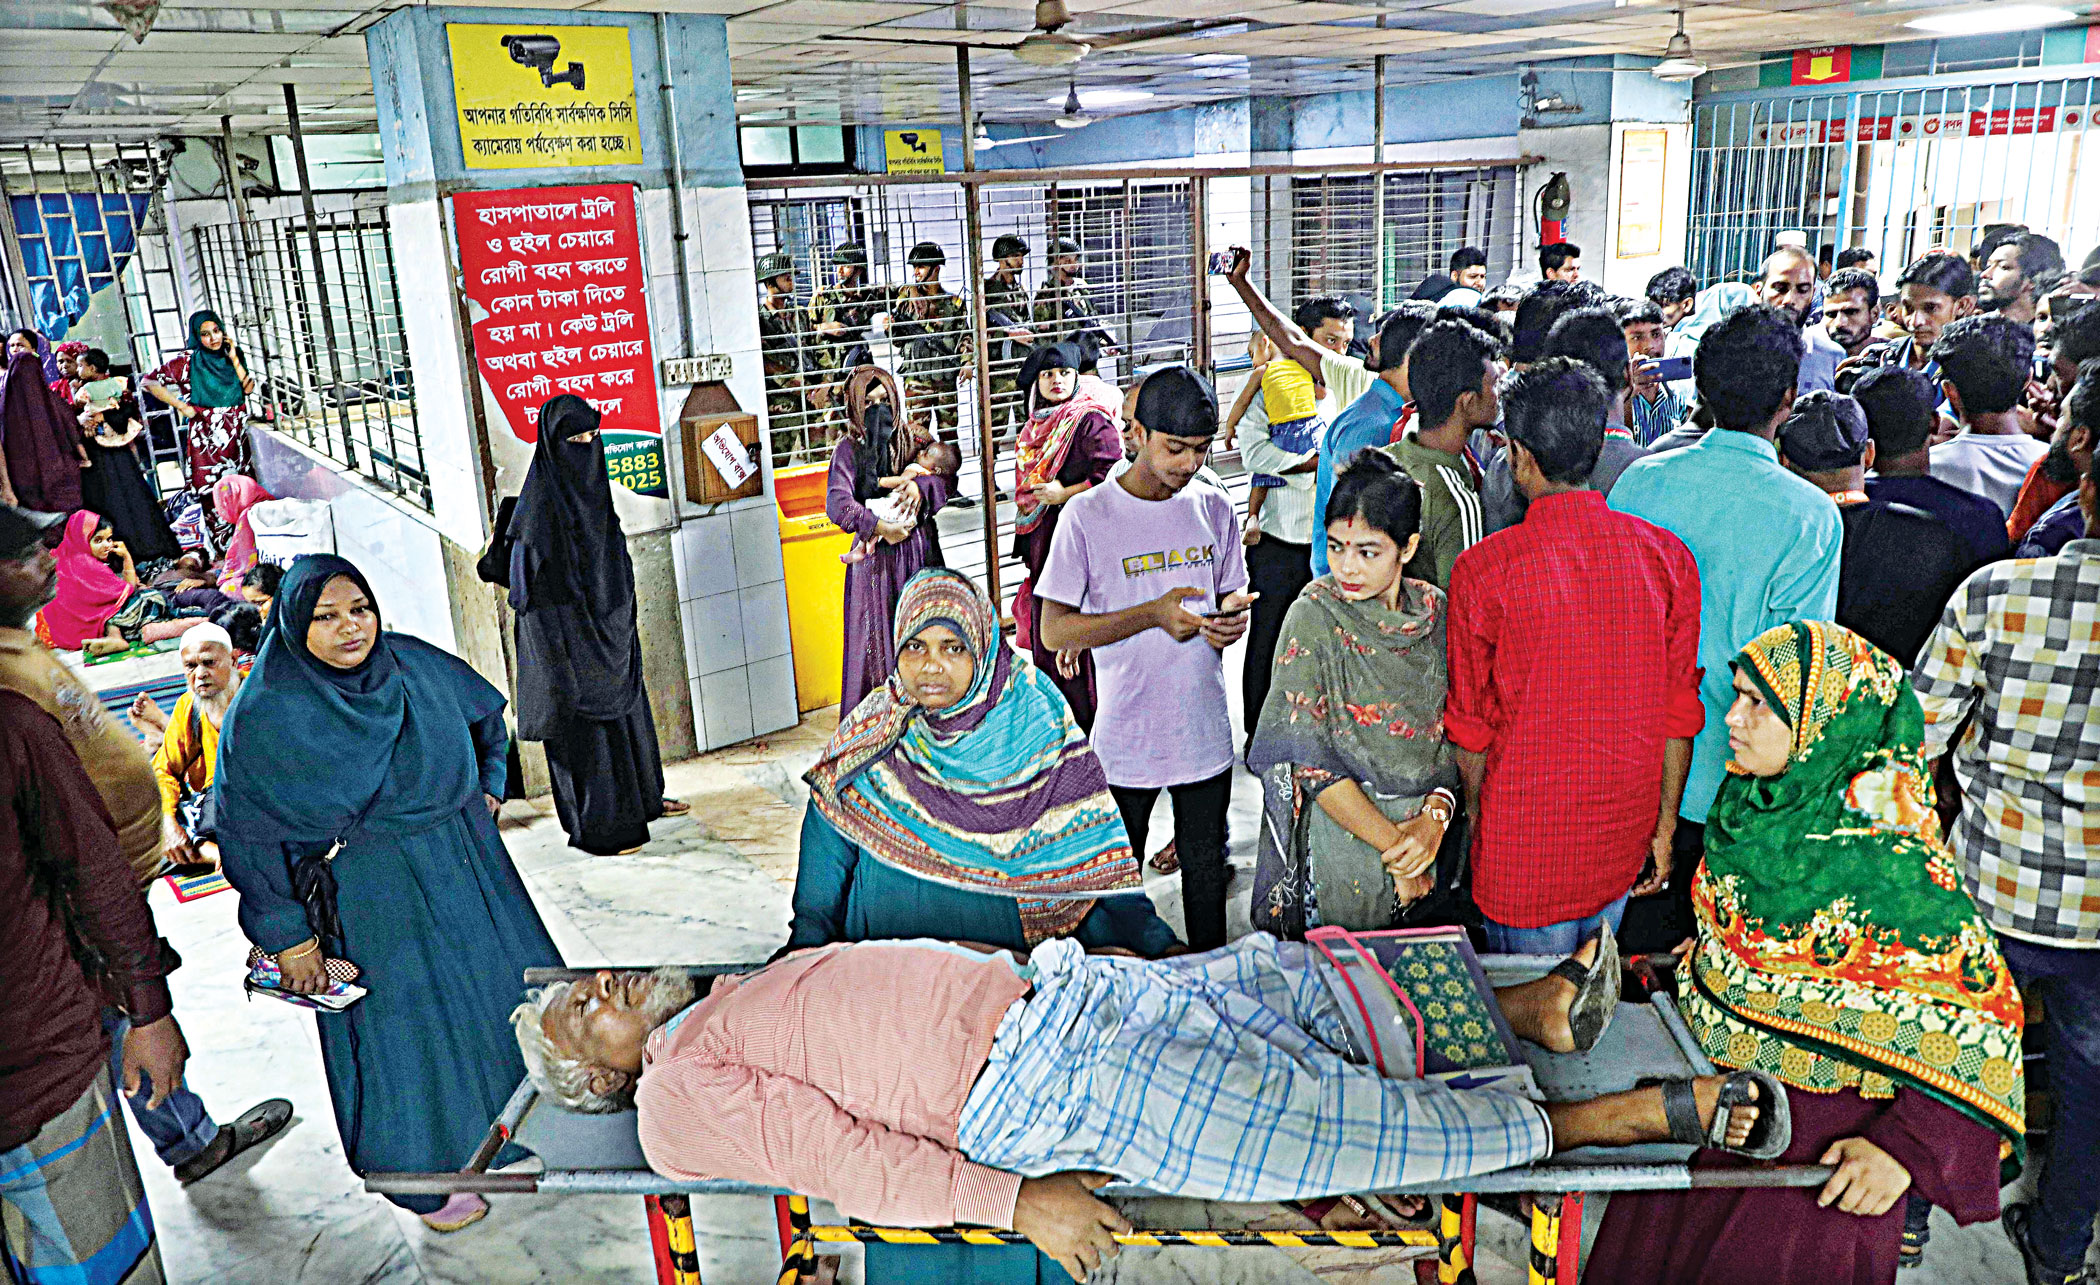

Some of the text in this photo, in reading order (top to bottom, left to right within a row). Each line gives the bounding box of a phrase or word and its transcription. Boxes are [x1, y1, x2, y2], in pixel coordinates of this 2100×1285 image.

[463, 101, 632, 125] আপনার গতিবিধি সার্বক্ষণিক সিসি
[471, 137, 522, 155] ক্যামেরায়
[576, 135, 597, 151] করা
[476, 197, 616, 226] হাসপাতালে ট্রলি
[486, 228, 615, 256] ও হুইল চেয়ারে
[480, 257, 629, 286] রোগী বহন করতে
[490, 284, 627, 315] কোন টাকা দিতে
[487, 323, 515, 343] হয়
[560, 312, 599, 336] কেউ
[601, 310, 635, 333] ট্রলি
[485, 339, 645, 374] অথবা হুইল চেয়ারে
[506, 368, 635, 402] রোগী বহন করে
[607, 452, 660, 476] 5883
[713, 432, 737, 466] অভিযোগ
[1123, 543, 1214, 574] BLACK
